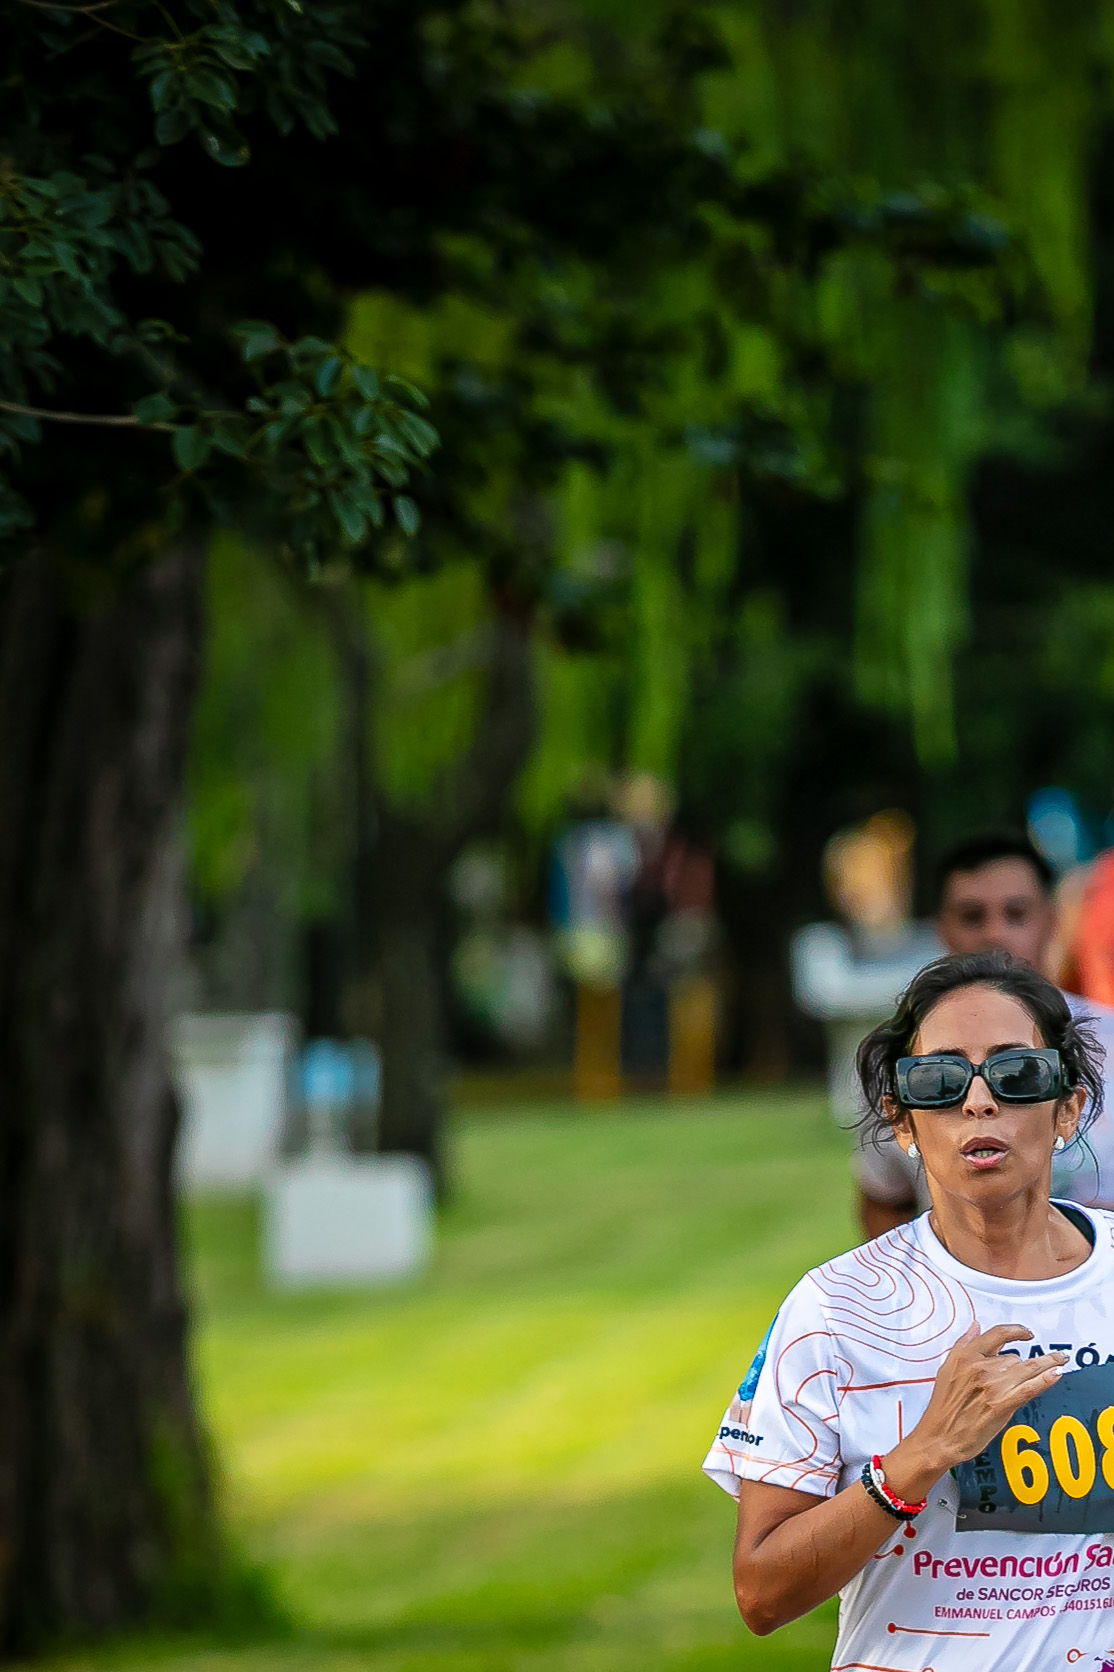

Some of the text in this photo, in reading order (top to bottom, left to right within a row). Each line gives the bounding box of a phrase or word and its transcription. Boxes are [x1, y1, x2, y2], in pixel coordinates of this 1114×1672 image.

[975, 1452, 998, 1513] EMPO
[913, 1550, 1080, 1579] Prevención
[956, 1587, 975, 1601] de
[978, 1587, 1043, 1601] SANCOR
[1006, 1605, 1056, 1620] CAMPOS
